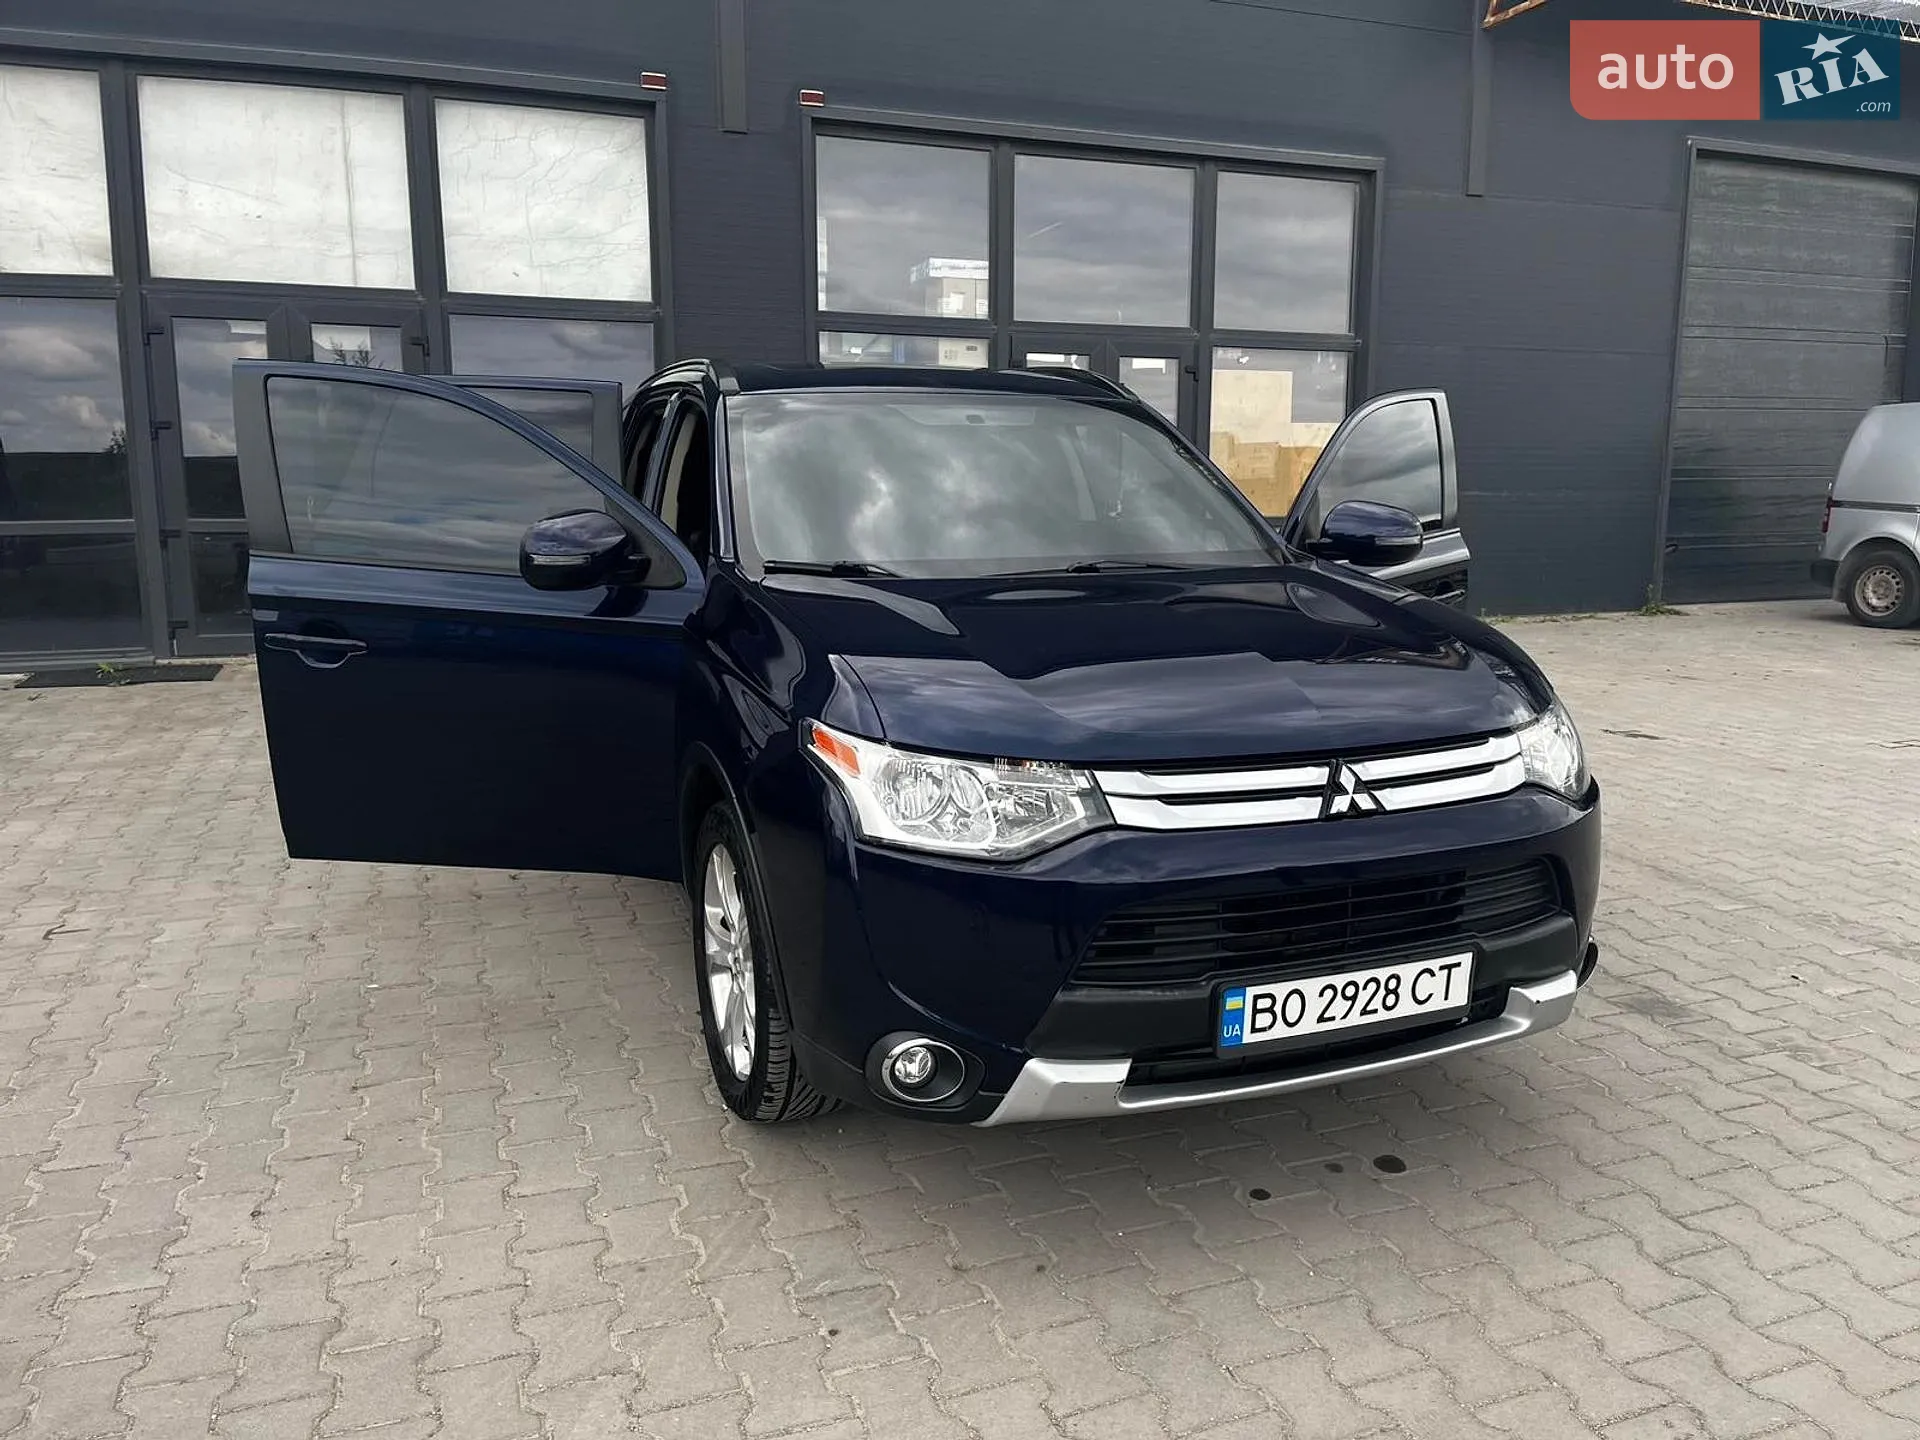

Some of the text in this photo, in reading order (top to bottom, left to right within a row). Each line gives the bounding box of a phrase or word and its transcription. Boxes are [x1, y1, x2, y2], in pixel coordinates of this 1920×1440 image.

[1250, 961, 1462, 1034] BO 2928 CT
[1223, 1025, 1241, 1038] UA
